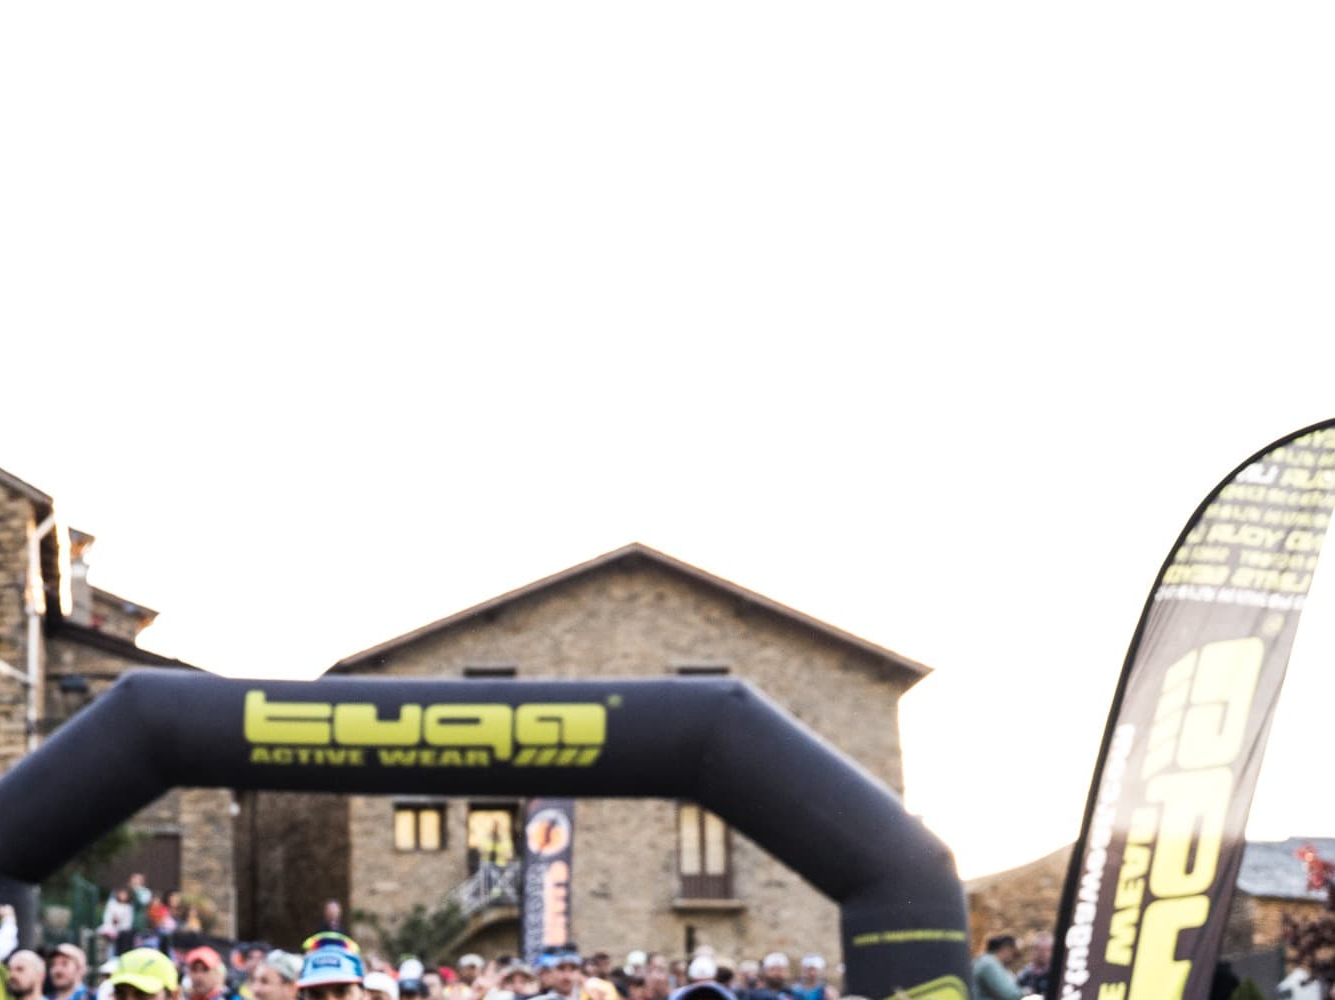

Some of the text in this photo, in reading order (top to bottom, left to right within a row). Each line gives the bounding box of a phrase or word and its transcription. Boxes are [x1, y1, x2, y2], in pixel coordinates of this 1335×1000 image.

[244, 690, 607, 761] tuga
[250, 746, 491, 767] ACTIVE WEAR
